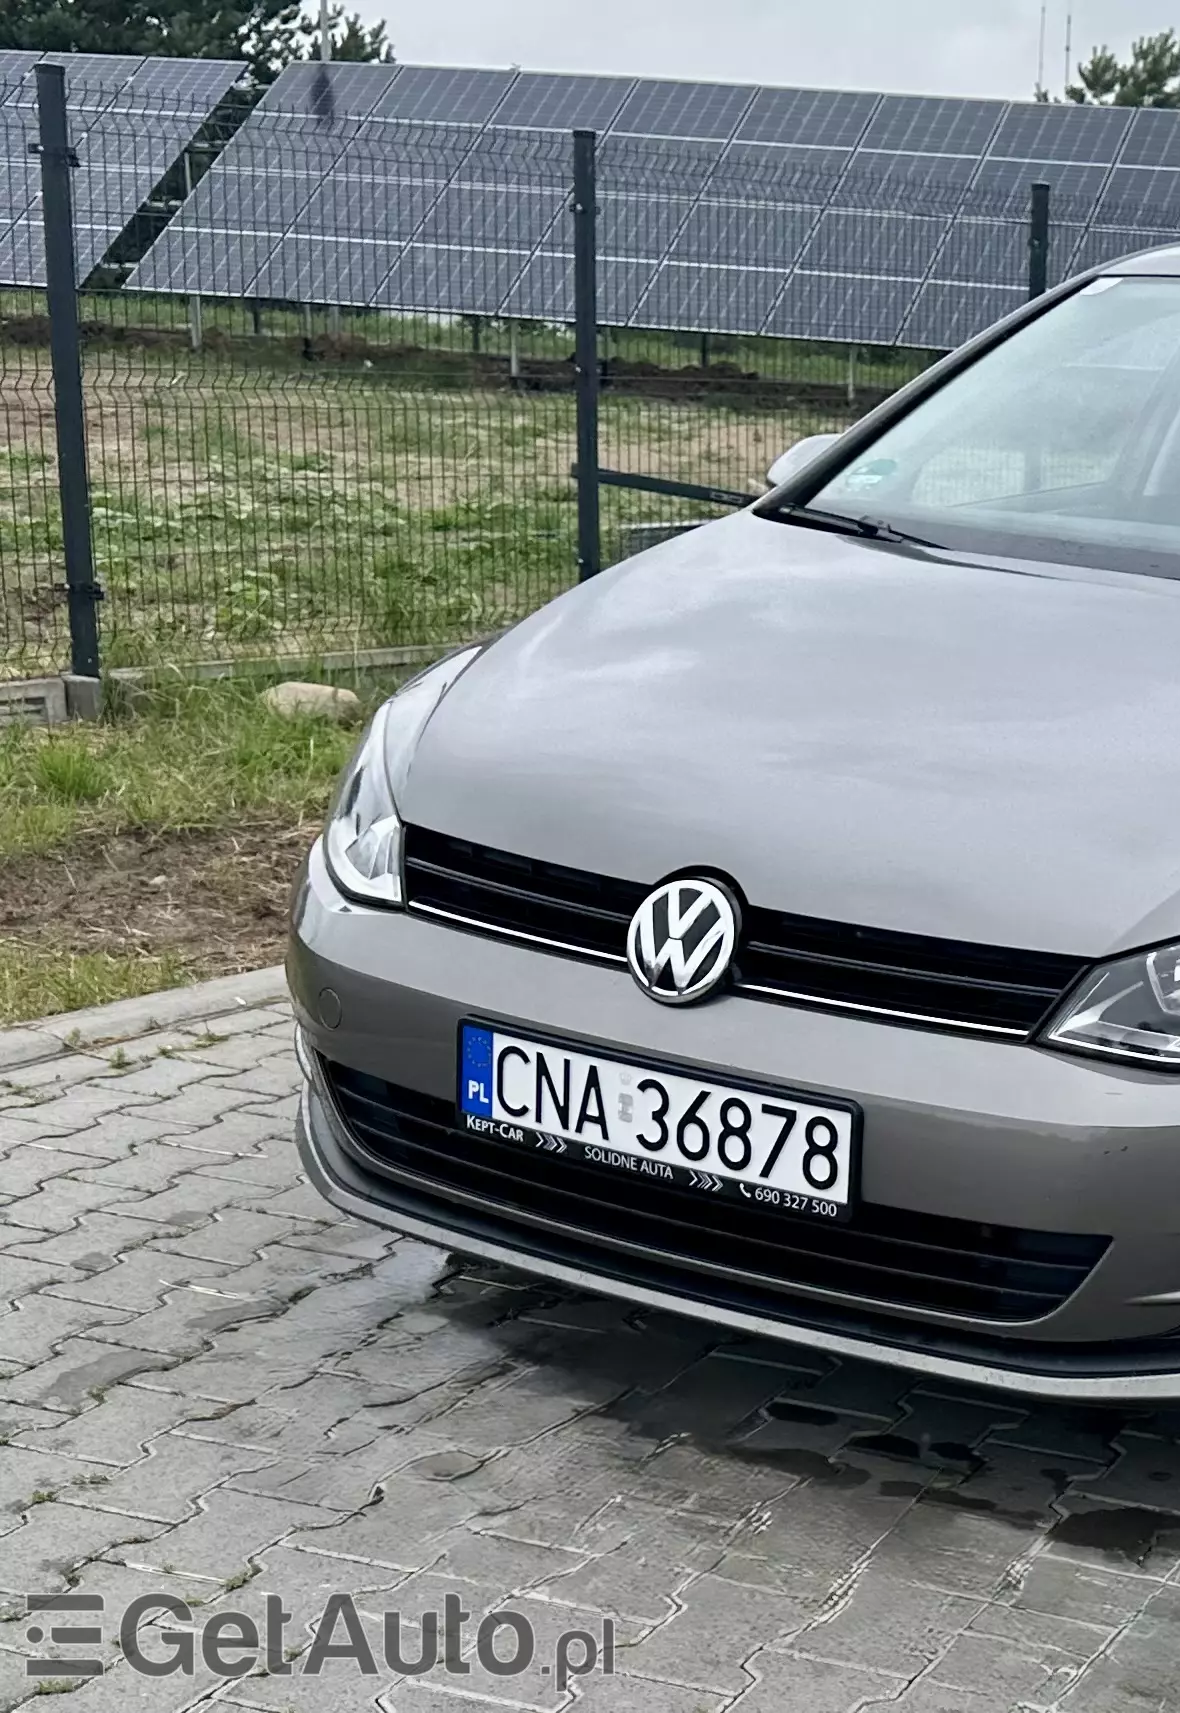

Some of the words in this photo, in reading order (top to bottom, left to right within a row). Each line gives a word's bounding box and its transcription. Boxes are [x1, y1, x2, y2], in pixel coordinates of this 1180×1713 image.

[468, 1079, 489, 1104] PL
[497, 1045, 610, 1141] CNA
[636, 1078, 839, 1191] 36878
[466, 1115, 524, 1142] KEPT-CAR
[584, 1146, 637, 1171] SOLIDNE
[640, 1160, 674, 1180] AUTA
[755, 1186, 780, 1204] 690
[783, 1192, 809, 1211] 327
[811, 1201, 838, 1217] 500
